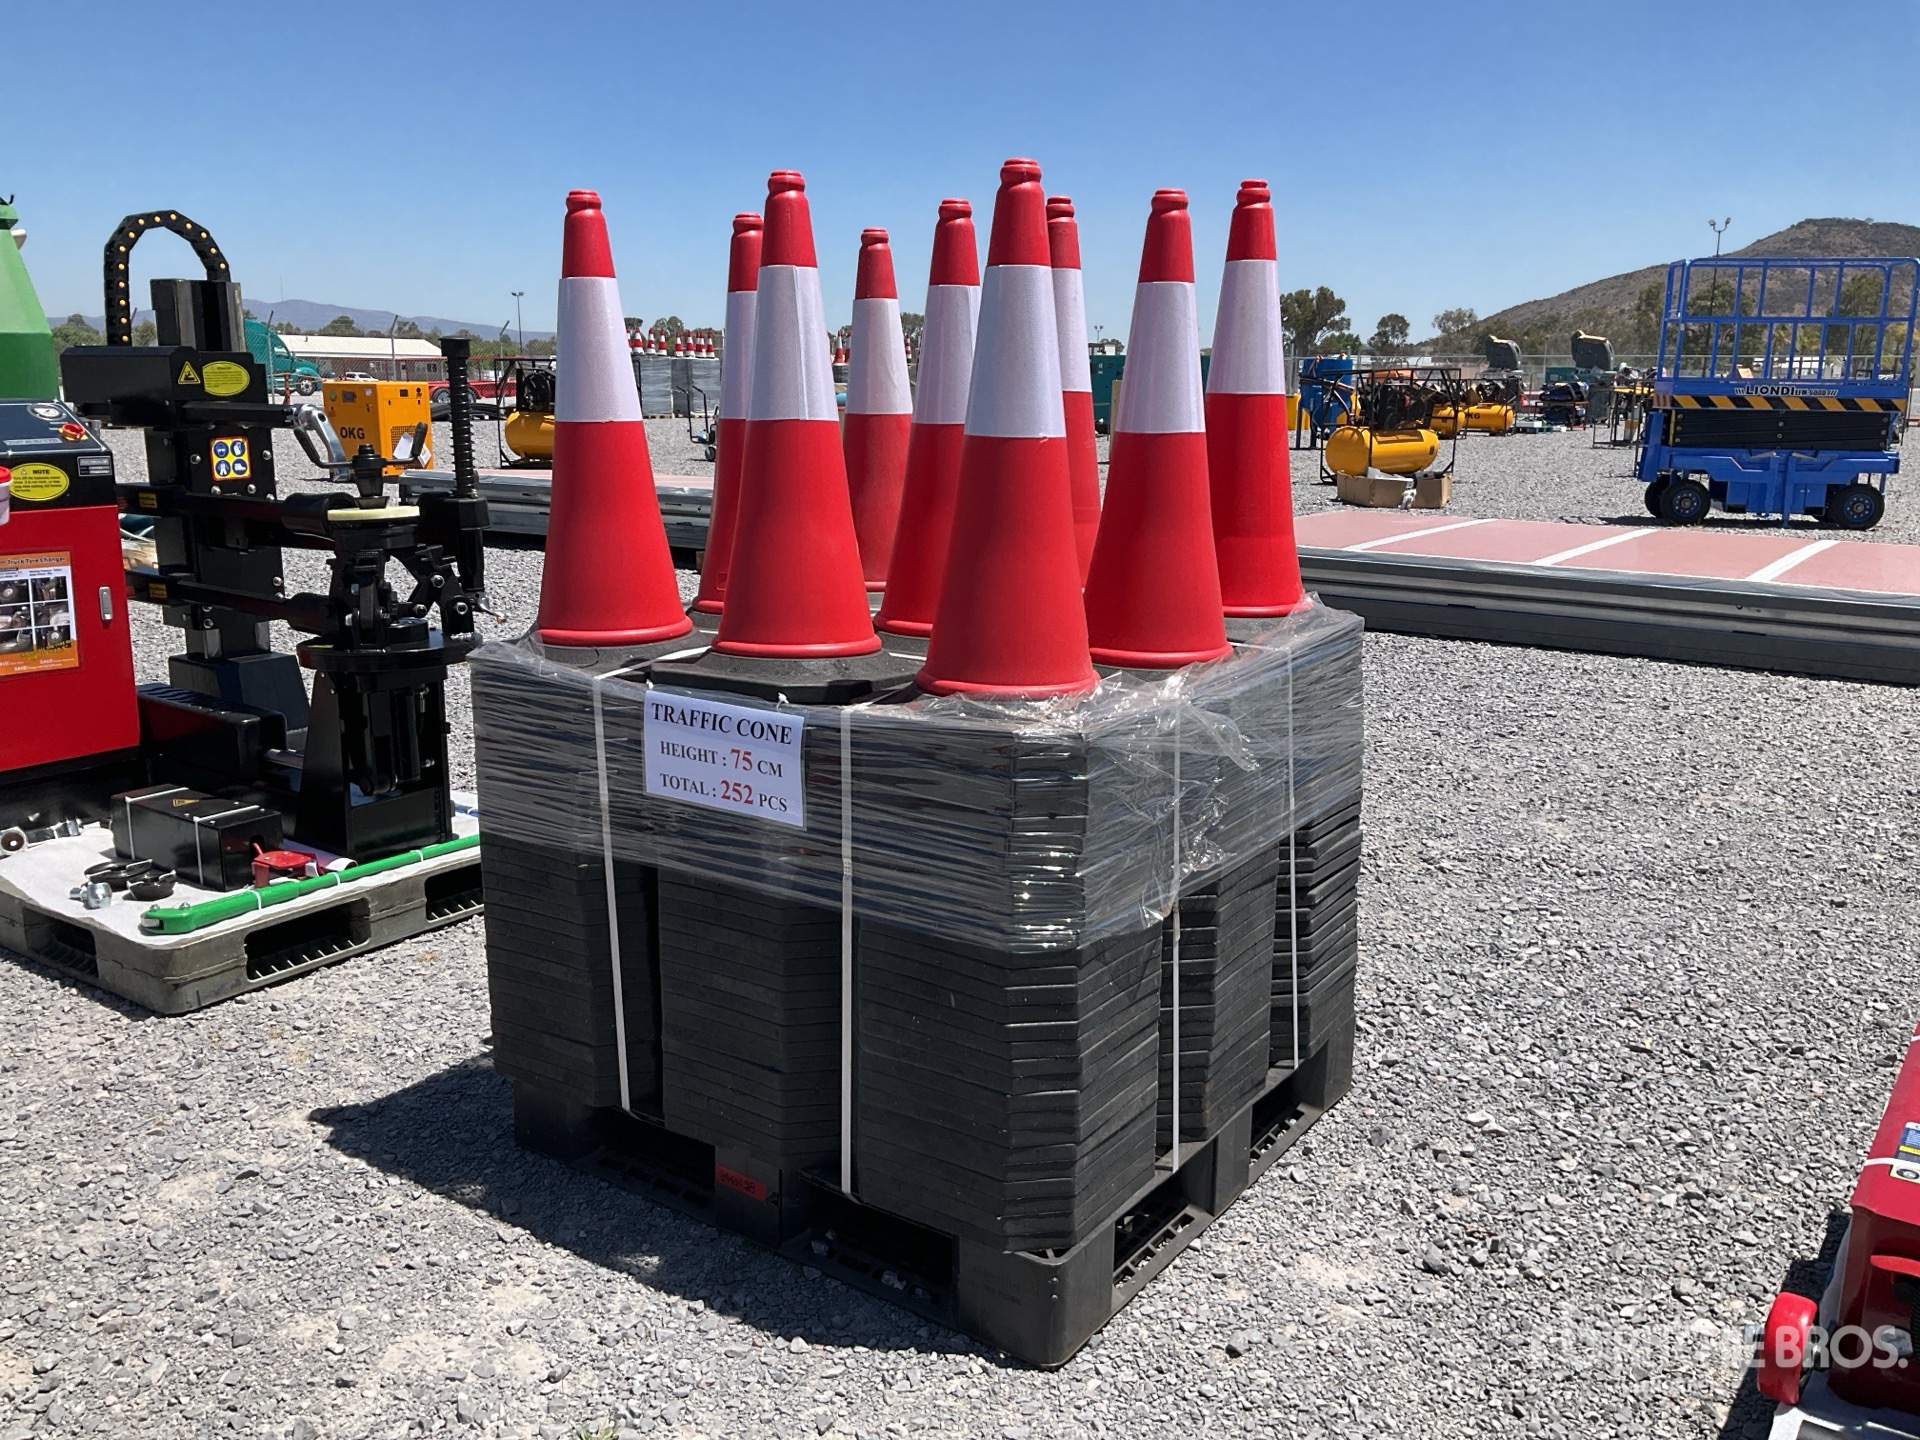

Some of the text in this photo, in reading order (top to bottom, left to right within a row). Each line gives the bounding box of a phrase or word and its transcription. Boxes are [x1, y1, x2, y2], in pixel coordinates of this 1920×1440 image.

[1745, 385, 1795, 396] LIONDI
[340, 427, 365, 439] OKG
[651, 702, 792, 745] TRAFFIC CONE
[660, 740, 718, 765] HEIGHT
[730, 748, 753, 772] 75
[757, 759, 783, 778] CM
[659, 772, 710, 796] TOTAL
[720, 779, 754, 805] 252
[758, 793, 788, 812] PCS
